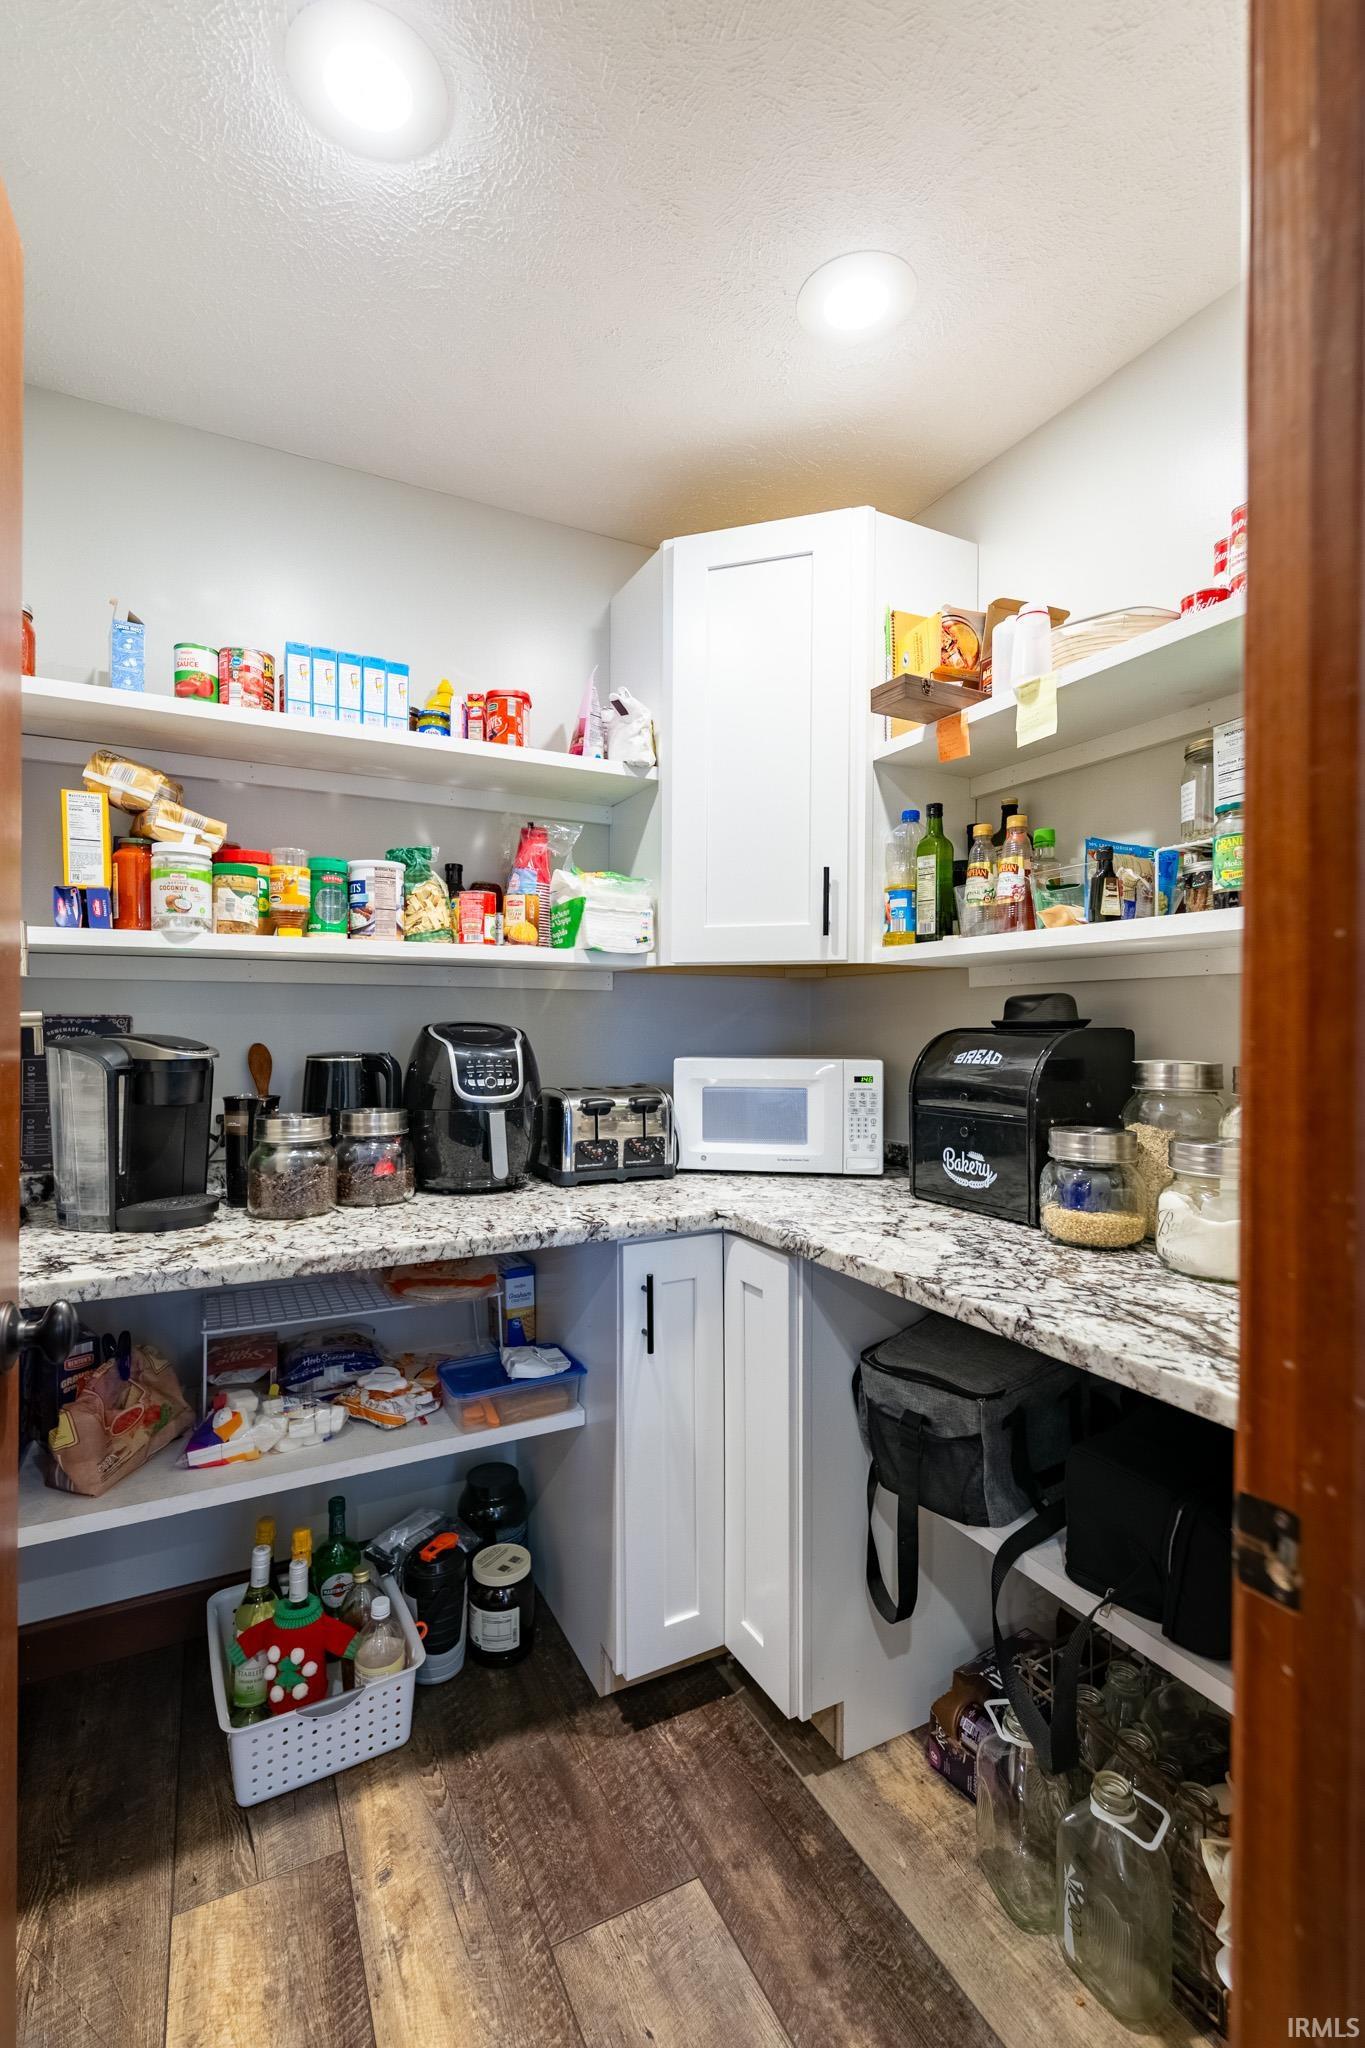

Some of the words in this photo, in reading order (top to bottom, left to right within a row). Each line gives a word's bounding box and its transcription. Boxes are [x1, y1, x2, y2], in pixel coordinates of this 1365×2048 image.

[176, 660, 199, 668] SAUCE
[954, 1049, 1003, 1064] BREAD
[943, 1146, 993, 1187] Bakery
[302, 1355, 321, 1366] Herb
